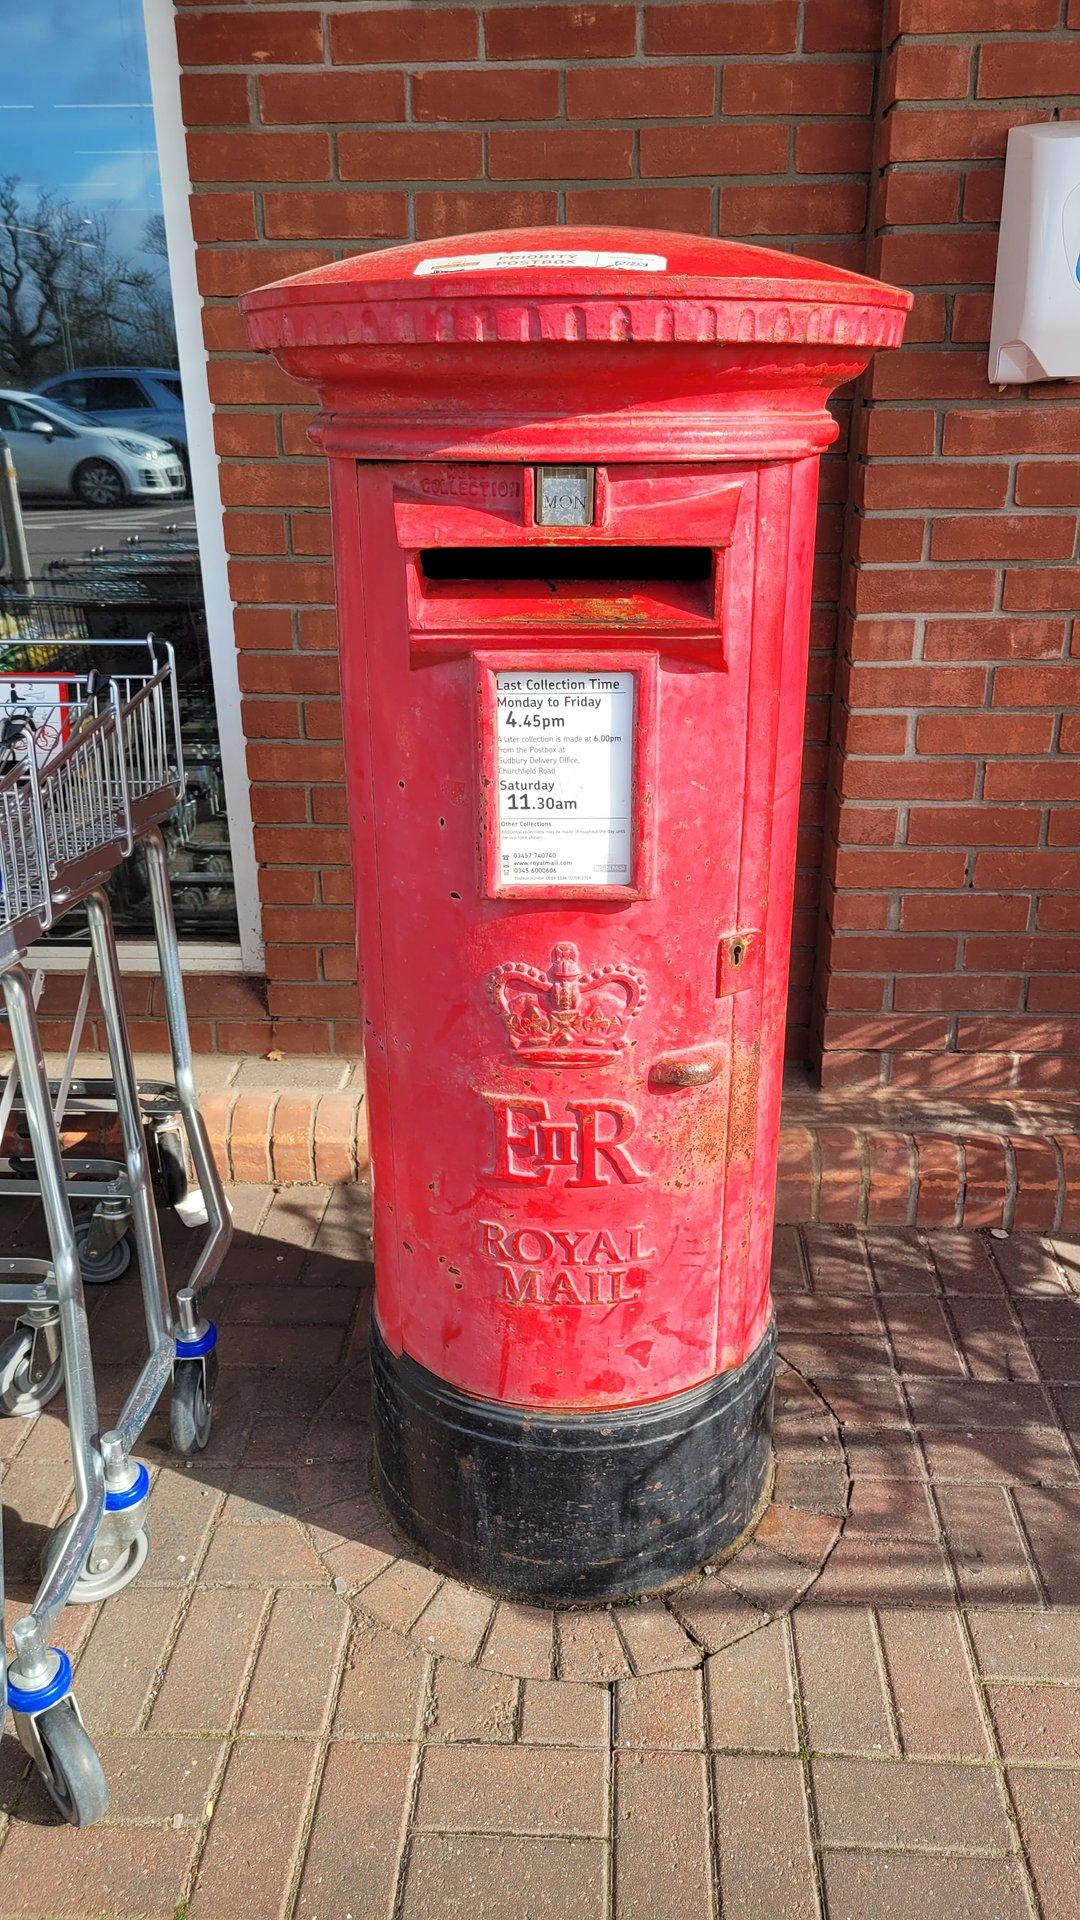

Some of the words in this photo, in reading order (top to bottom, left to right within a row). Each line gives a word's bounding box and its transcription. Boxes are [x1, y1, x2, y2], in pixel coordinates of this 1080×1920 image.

[420, 477, 520, 498] COLLECTION
[543, 495, 587, 510] MON
[496, 679, 522, 691] Last
[526, 679, 585, 691] Collection
[589, 678, 620, 690] Time
[497, 696, 543, 709] Monday
[548, 697, 559, 707] to
[564, 696, 601, 709] Friday
[505, 710, 565, 730] 4.45pm
[503, 735, 519, 743] later
[521, 735, 554, 743] collection
[555, 735, 562, 743] is
[563, 735, 583, 743] made
[584, 735, 592, 743] at
[593, 734, 622, 744] 6.00pm
[499, 756, 527, 765] Sudbury
[529, 756, 557, 765] Delivery
[498, 767, 536, 775] Churchfield
[538, 767, 556, 775] Road
[499, 780, 555, 792] Saturday
[507, 793, 577, 810] 11.30am
[478, 1219, 656, 1266] ROYAL
[497, 1261, 641, 1305] MAIL
